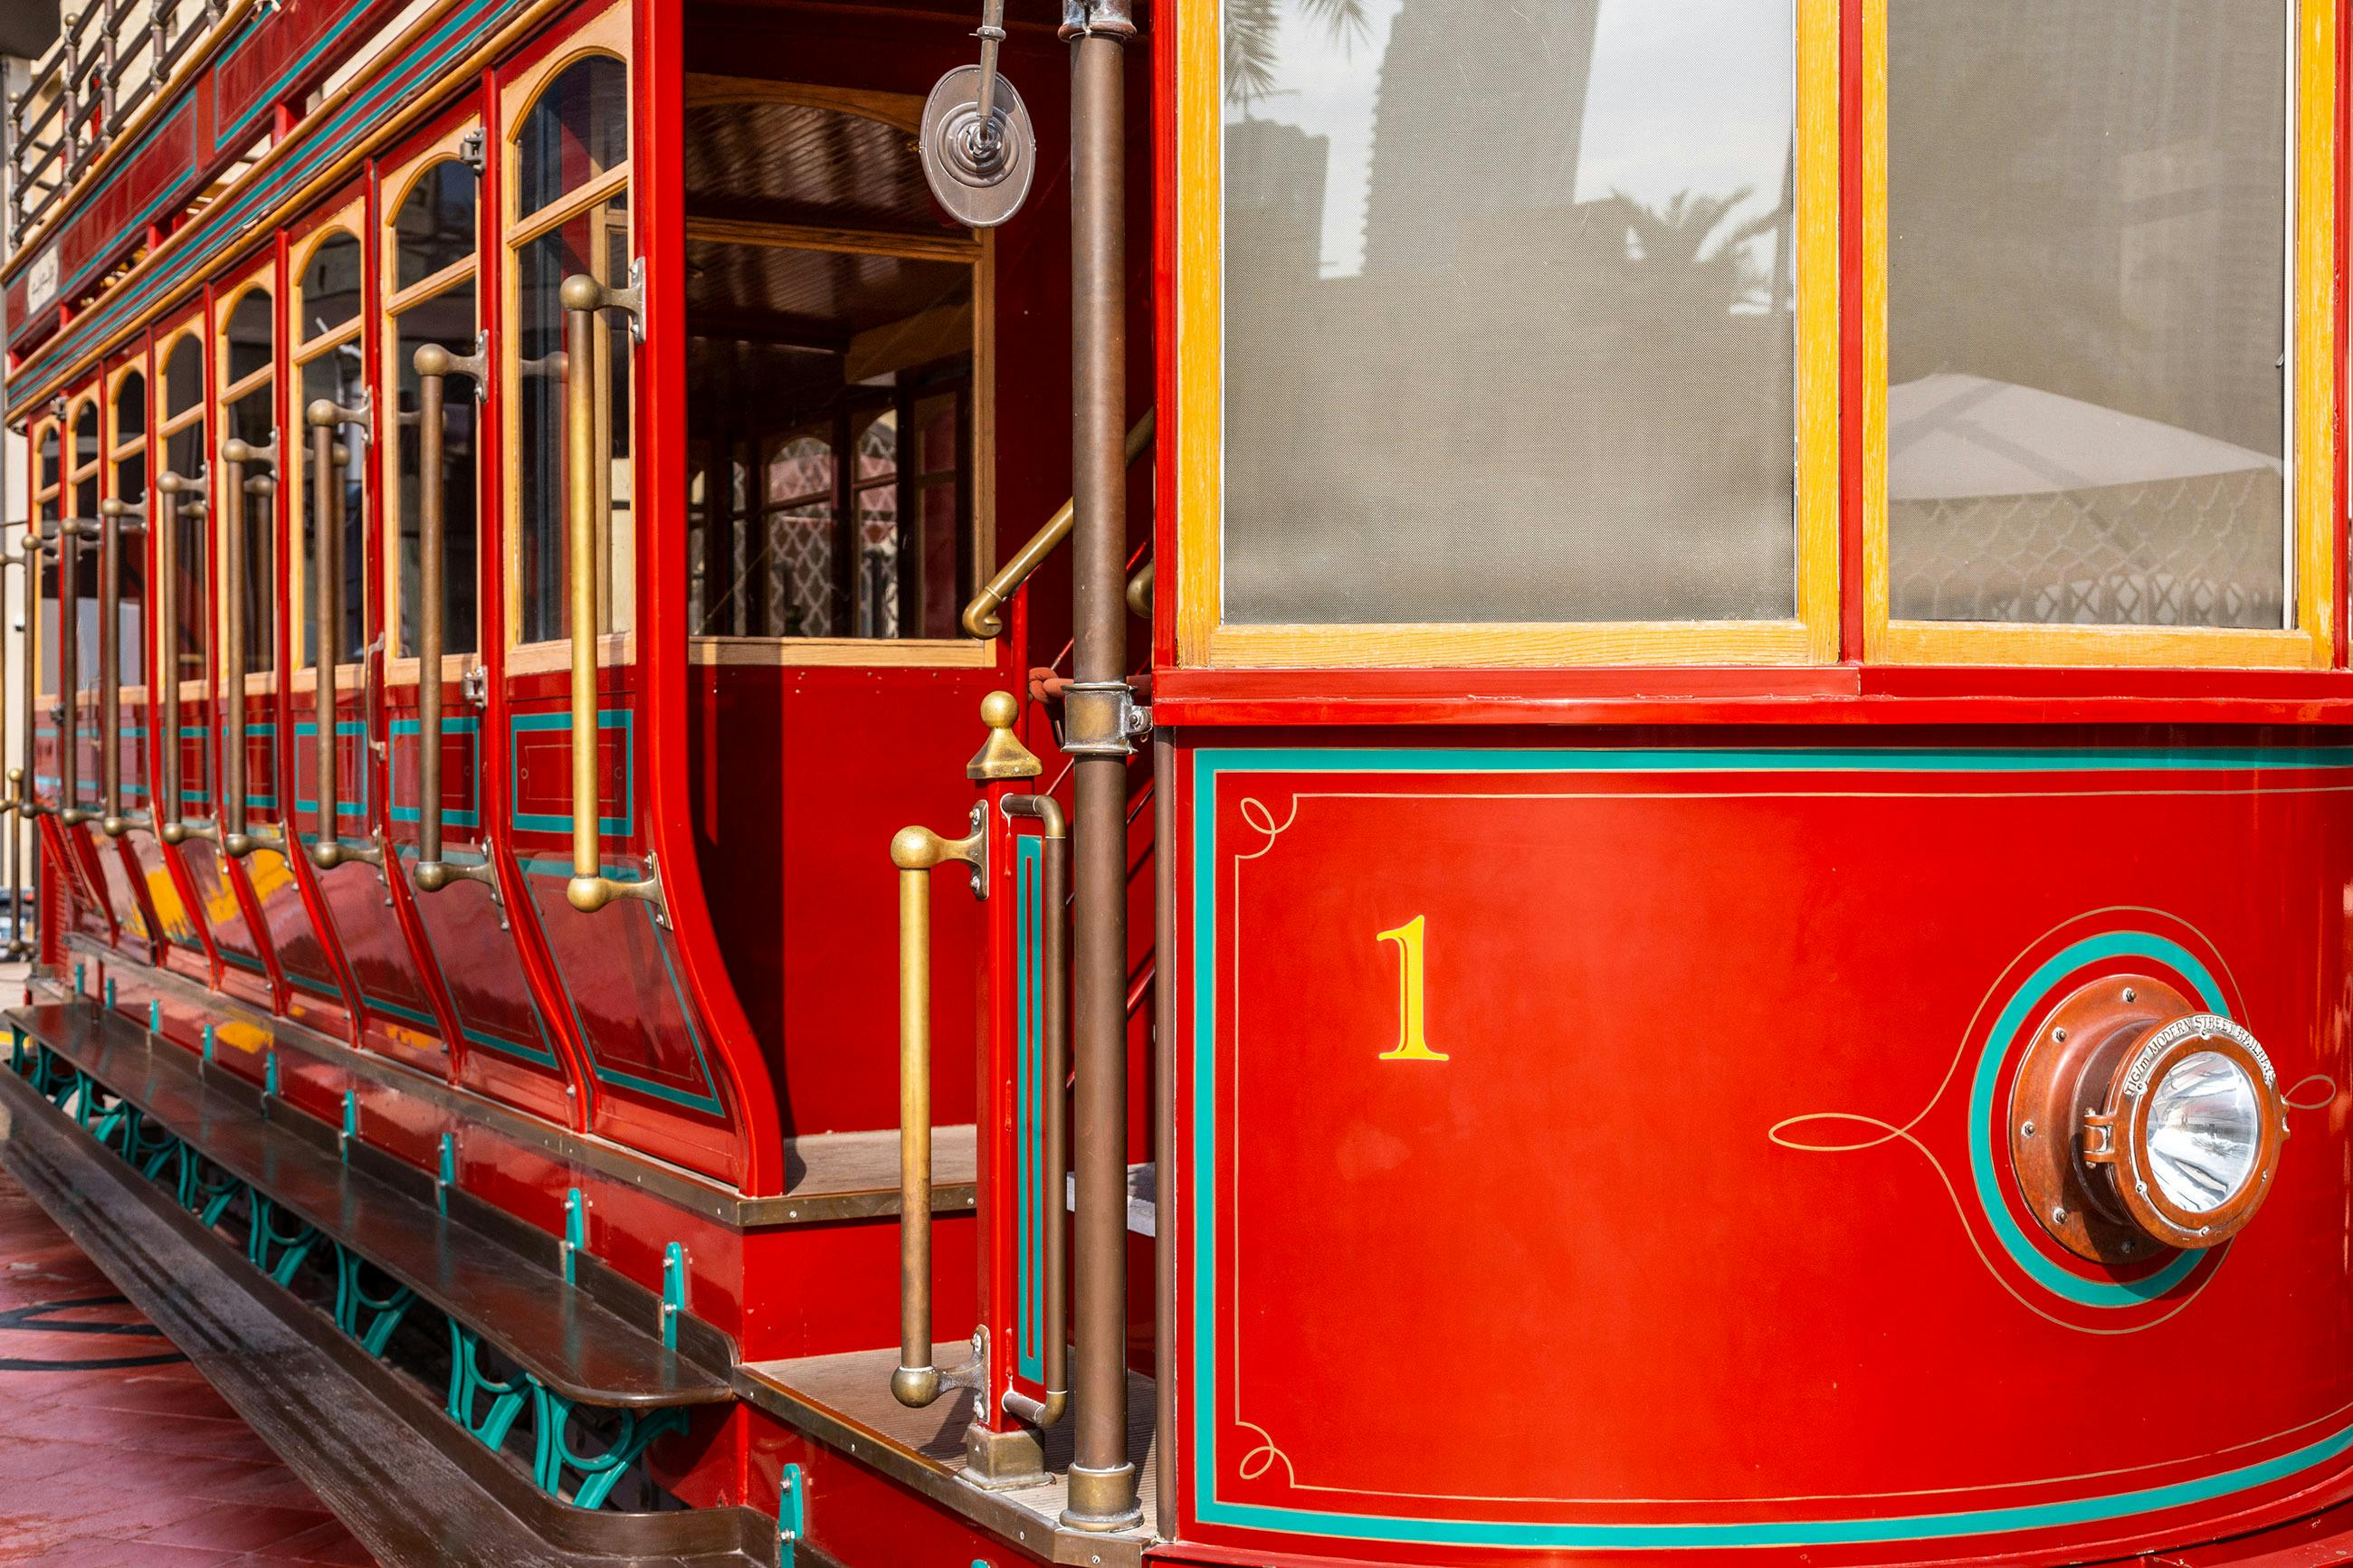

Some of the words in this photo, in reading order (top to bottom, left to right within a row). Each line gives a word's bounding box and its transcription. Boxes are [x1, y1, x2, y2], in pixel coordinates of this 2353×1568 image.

[1376, 914, 1450, 1061] 1
[2124, 1056, 2150, 1096] TIG/m
[2148, 1017, 2193, 1057] MODERN
[2194, 1015, 2235, 1034] STREET
[2236, 1025, 2277, 1084] RAILWAYS
